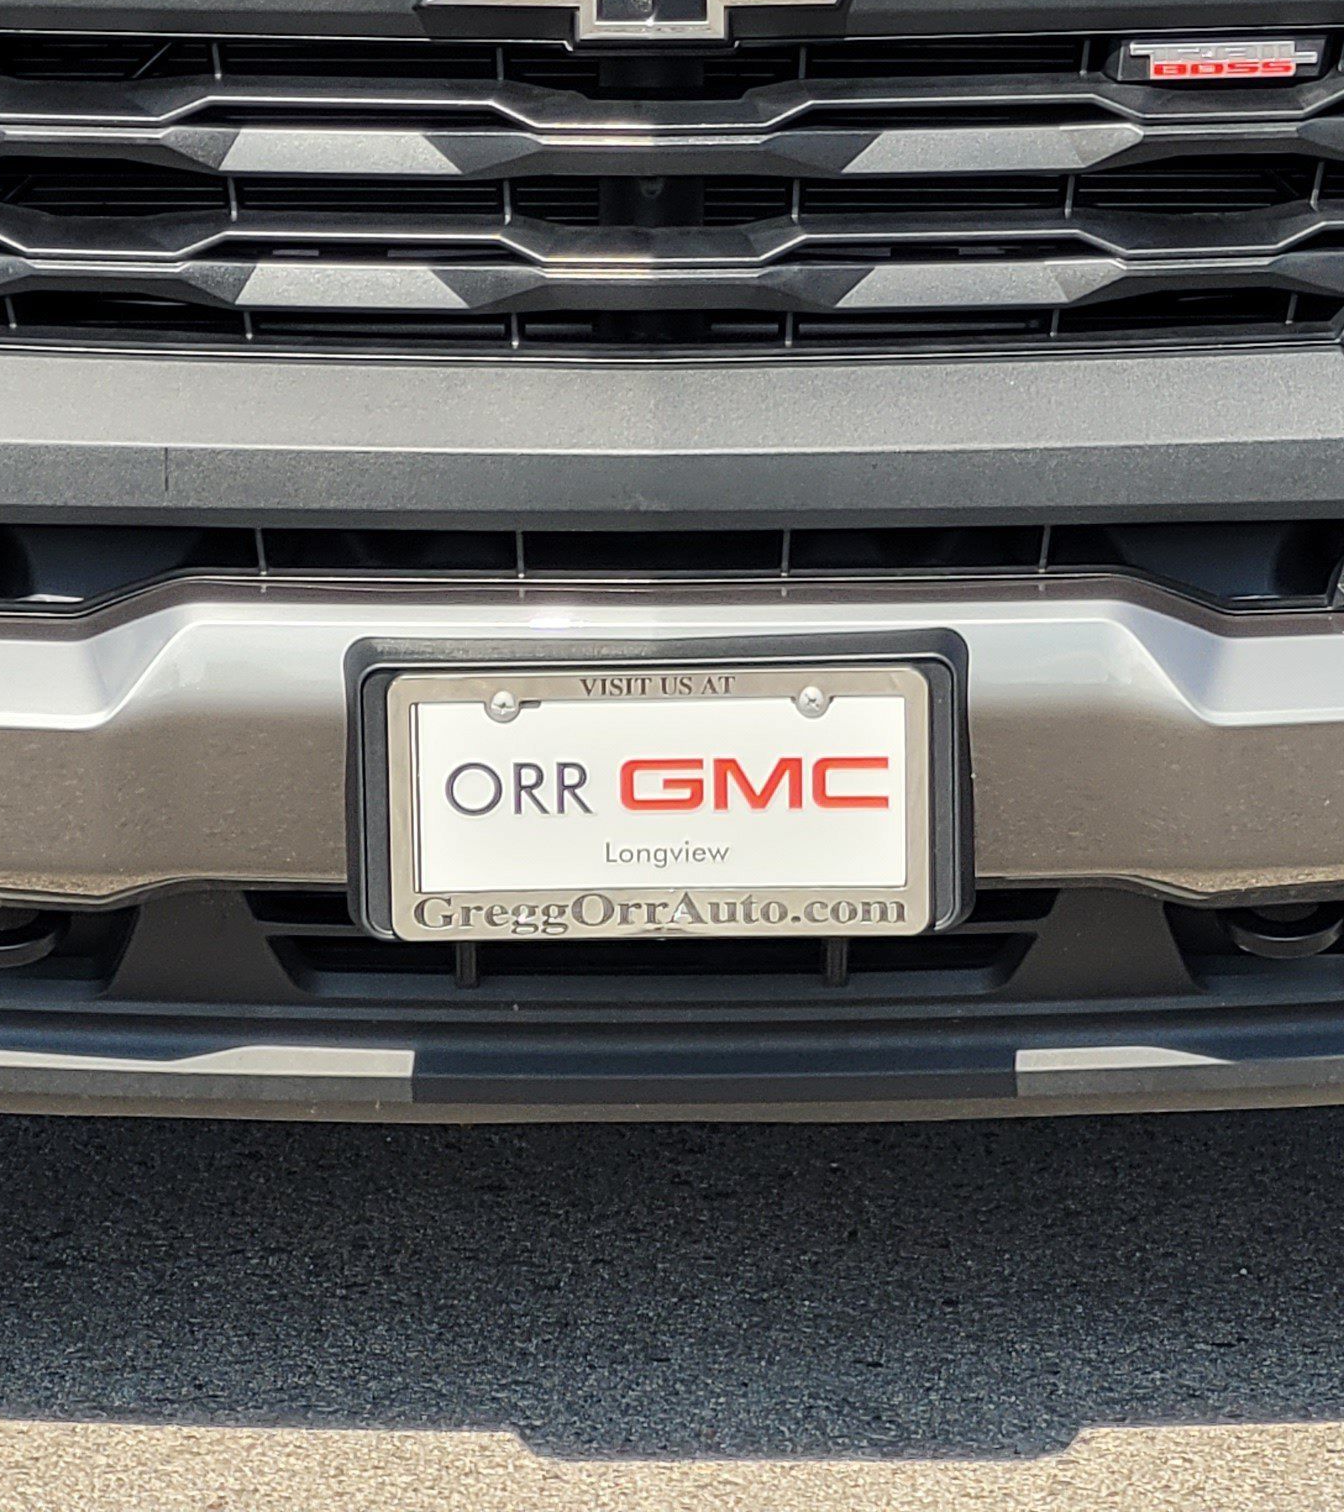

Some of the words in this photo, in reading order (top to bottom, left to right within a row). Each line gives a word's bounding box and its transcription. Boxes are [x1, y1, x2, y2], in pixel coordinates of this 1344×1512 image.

[1152, 60, 1295, 79] BOSS
[579, 677, 652, 697] VISIT
[659, 676, 693, 695] US
[701, 676, 736, 695] AT
[444, 761, 594, 815] ORR
[619, 756, 890, 811] GMC
[604, 840, 731, 868] Longview
[412, 891, 907, 935] GreggOrrAuto.com
